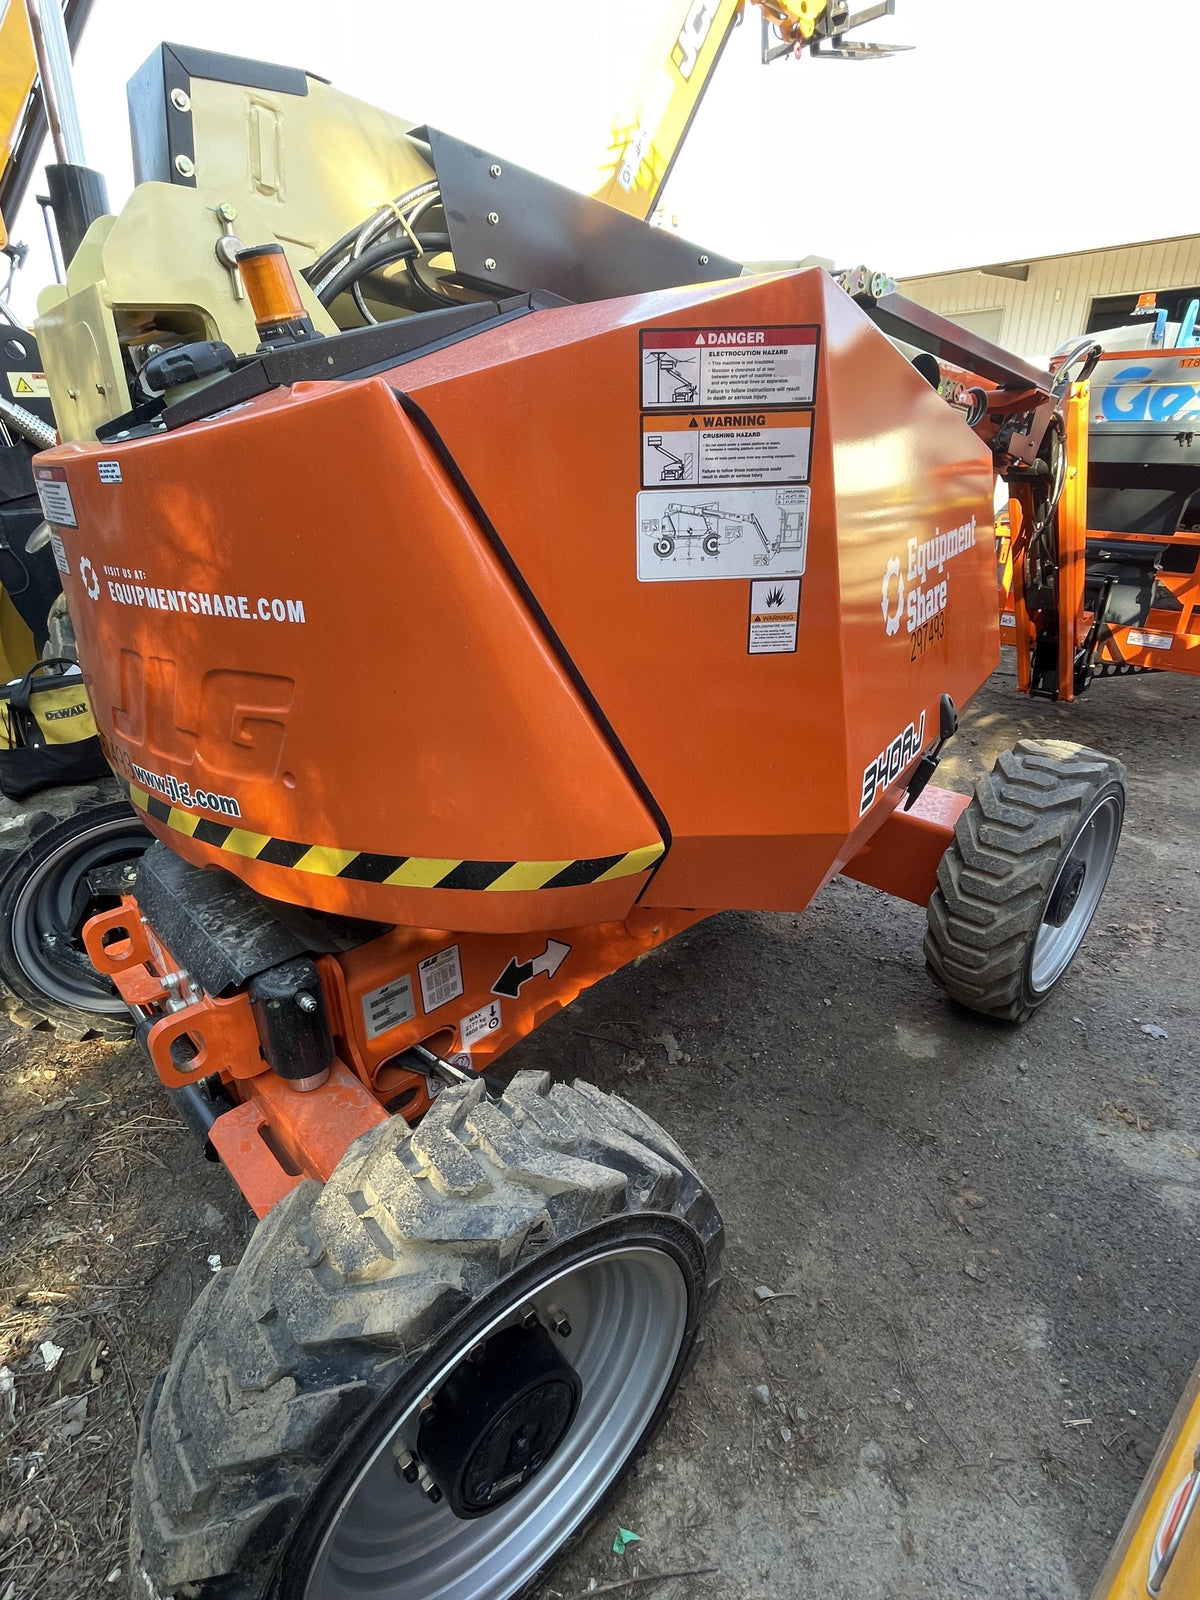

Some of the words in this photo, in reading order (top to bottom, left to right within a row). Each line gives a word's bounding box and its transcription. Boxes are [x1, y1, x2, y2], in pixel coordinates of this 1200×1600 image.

[708, 332, 765, 344] DANGER
[1101, 366, 1200, 422] Ge
[703, 415, 766, 427] WARNING
[103, 565, 120, 577] VISIT
[122, 568, 132, 579] US
[134, 570, 146, 580] AT:
[907, 514, 976, 584] Equipment
[108, 581, 306, 624] EQUIPMENTSHARE.COM
[907, 580, 948, 633] Share
[910, 611, 944, 662] 297493
[112, 648, 296, 784] JLG
[859, 709, 926, 818] 340AJ
[133, 763, 241, 818] www.jlg.com
[465, 1020, 478, 1031] 2177
[469, 1012, 482, 1022] MAX
